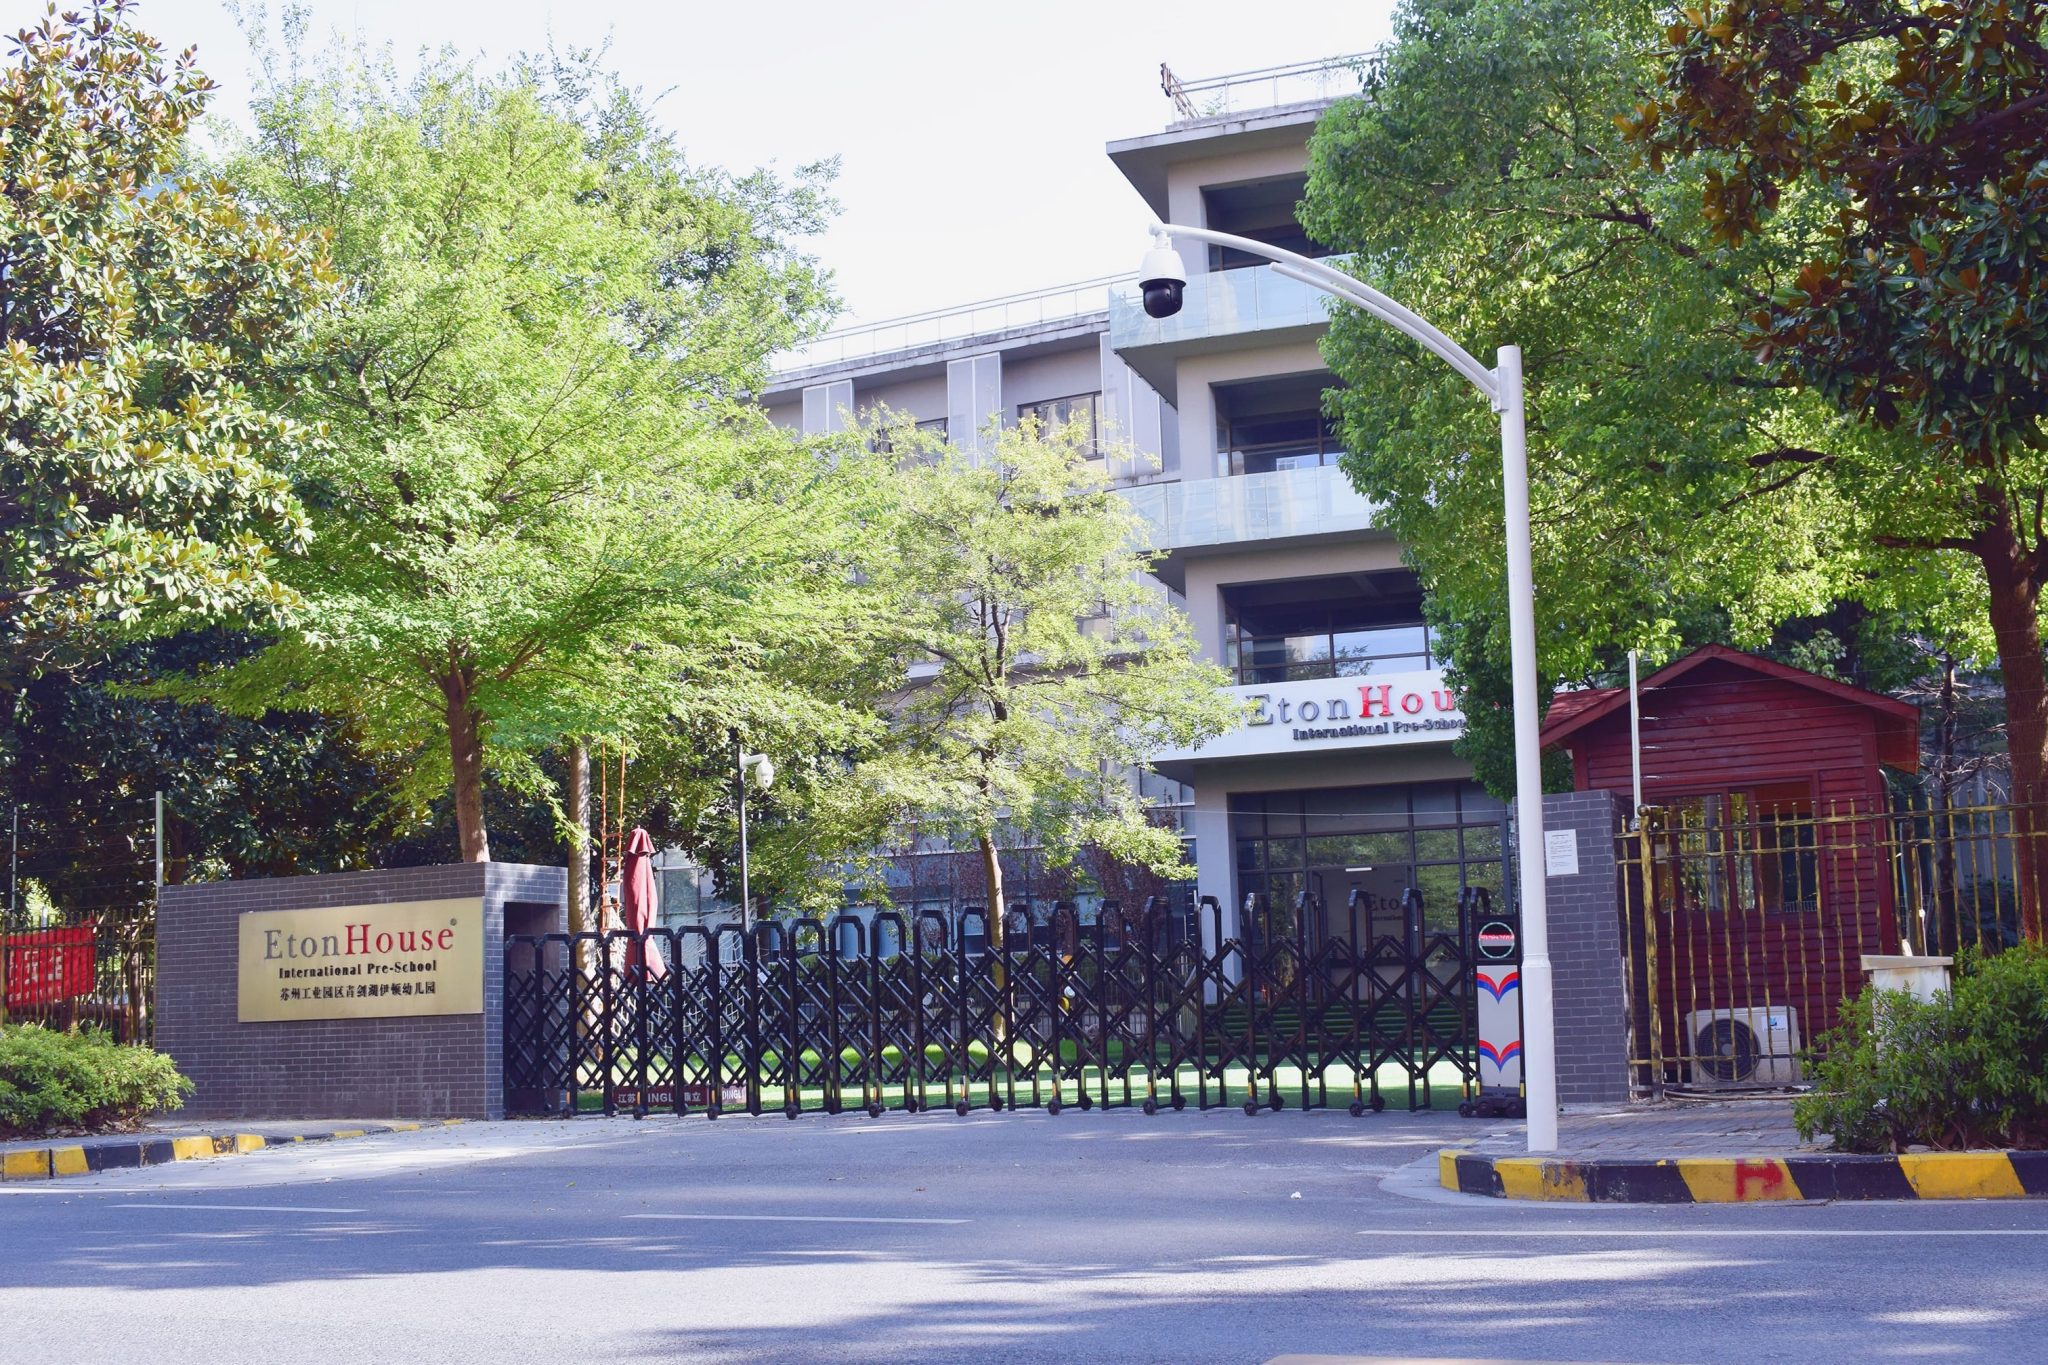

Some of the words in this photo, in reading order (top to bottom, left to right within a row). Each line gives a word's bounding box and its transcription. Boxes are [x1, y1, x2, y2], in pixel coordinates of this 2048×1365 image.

[1246, 684, 1472, 727] EtonHou
[1293, 722, 1389, 741] International
[1393, 718, 1466, 733] Pre-Schoo
[264, 924, 454, 960] EtonHouse
[279, 963, 362, 979] International
[367, 959, 437, 975] Pre-School
